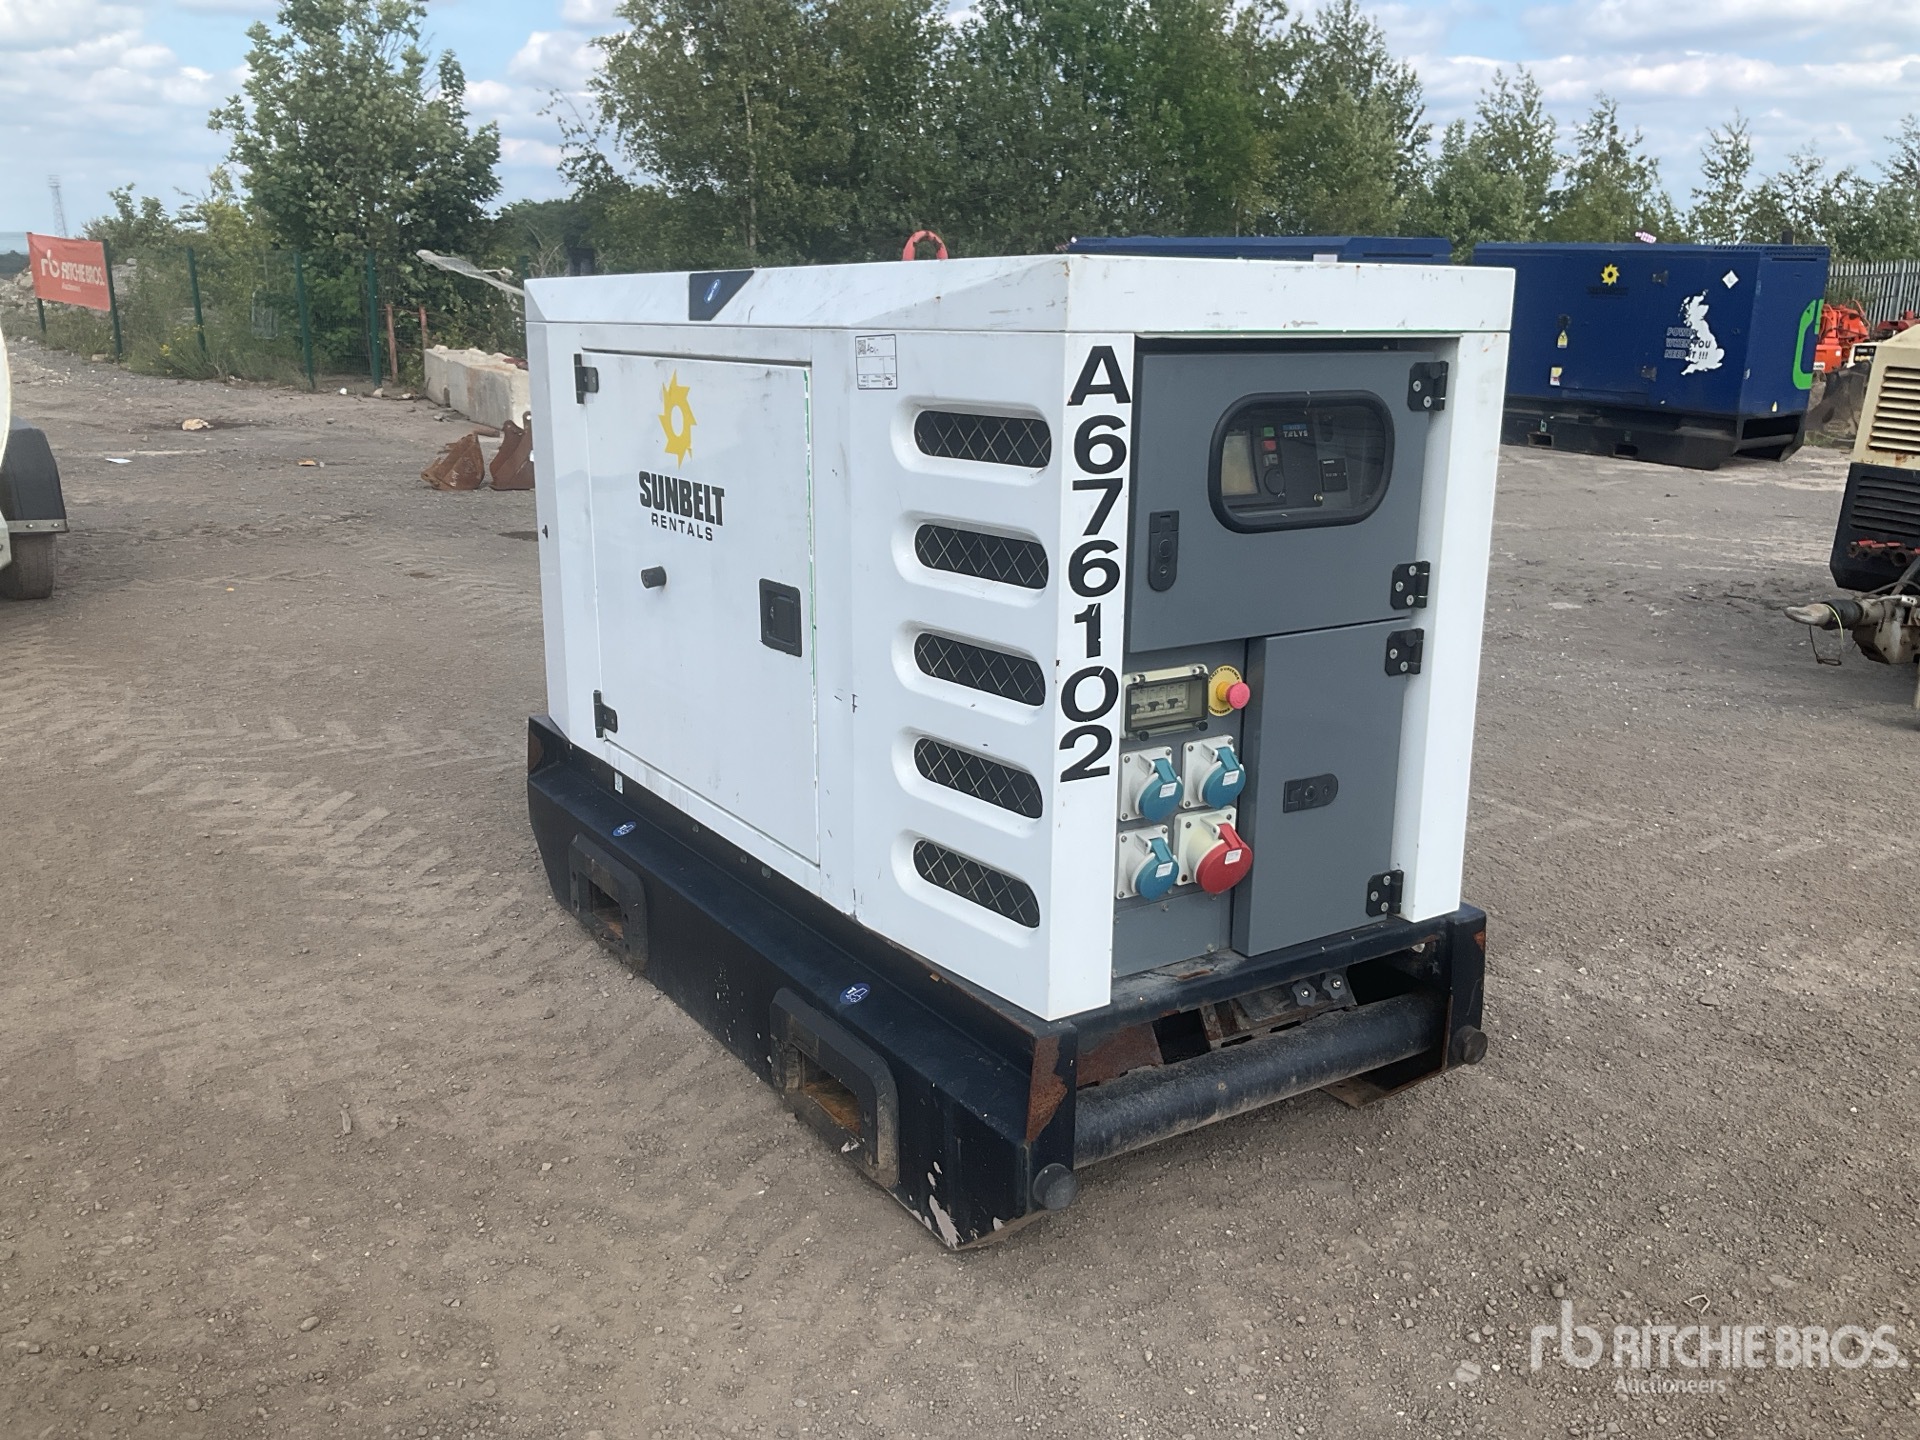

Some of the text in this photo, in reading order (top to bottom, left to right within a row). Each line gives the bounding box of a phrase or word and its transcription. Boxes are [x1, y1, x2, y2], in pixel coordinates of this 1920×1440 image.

[1666, 327, 1699, 337] POWER
[1665, 338, 1712, 349] WHEN YOU
[1664, 349, 1687, 359] NEED
[1687, 350, 1697, 359] IT
[638, 470, 725, 526] SUNBELT
[651, 512, 713, 541] RENTALS
[1059, 345, 1132, 783] A676102
